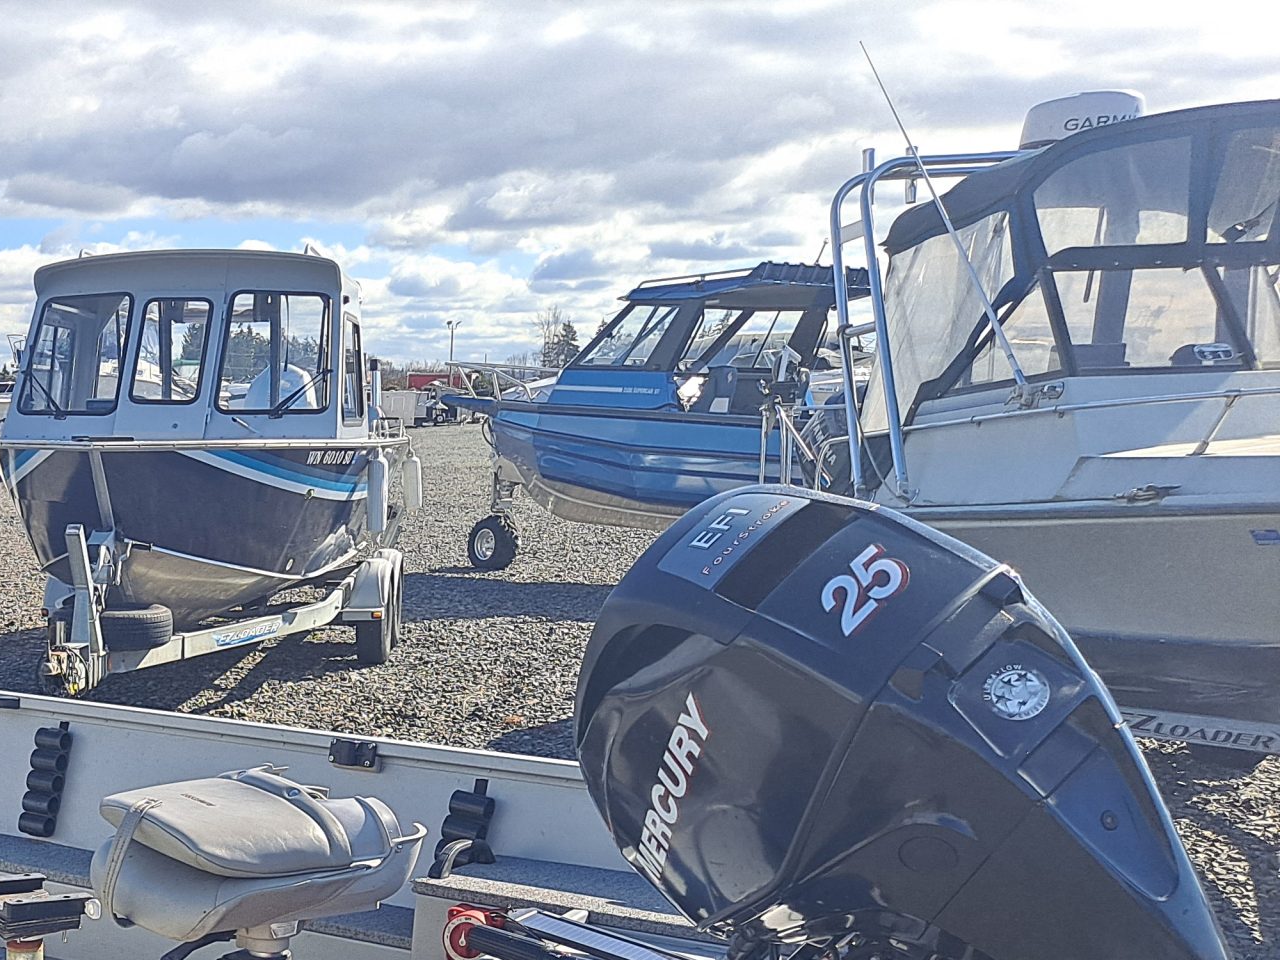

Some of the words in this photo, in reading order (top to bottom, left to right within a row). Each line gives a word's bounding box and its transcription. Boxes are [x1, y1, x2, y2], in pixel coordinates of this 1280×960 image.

[306, 450, 325, 465] WN
[323, 450, 345, 465] 6010
[689, 508, 750, 550] EFI
[701, 500, 790, 576] FourStroke
[821, 543, 910, 637] 25
[636, 690, 710, 880] MERCURY
